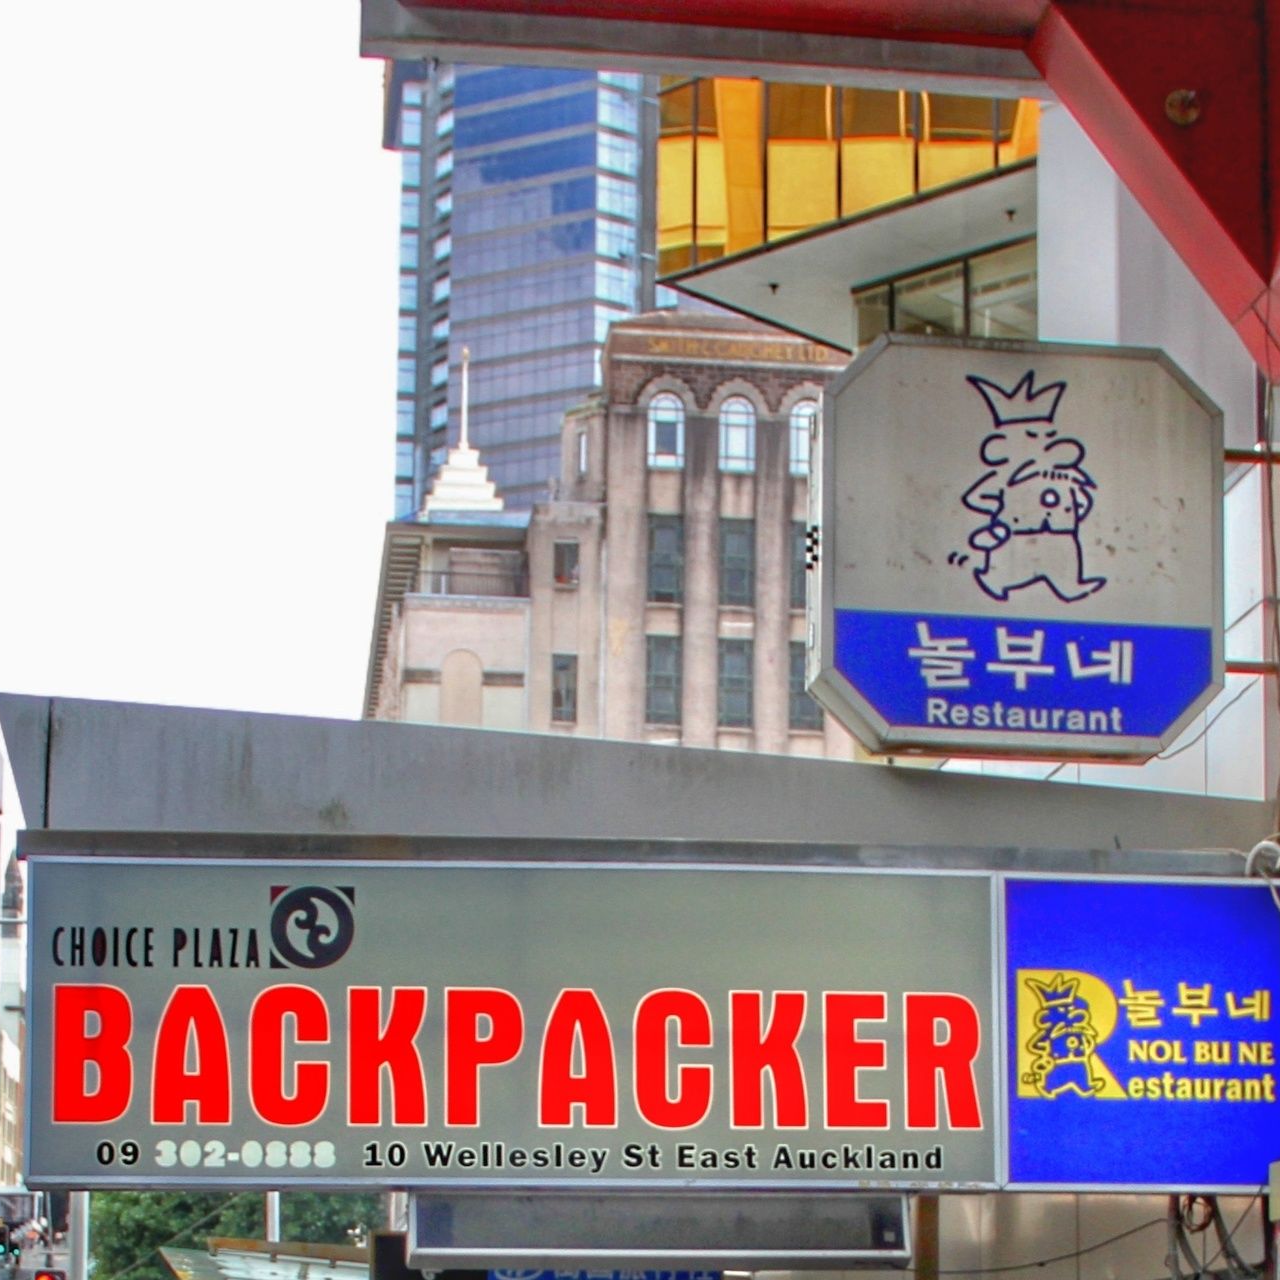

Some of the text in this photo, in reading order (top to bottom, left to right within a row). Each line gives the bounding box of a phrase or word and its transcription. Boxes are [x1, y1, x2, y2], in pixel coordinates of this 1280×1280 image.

[908, 620, 1134, 691] 놀부네
[926, 696, 1123, 733] Restaurant
[51, 926, 260, 969] CHOICE PLAZA
[1119, 980, 1270, 1028] 놀부네
[51, 983, 982, 1131] BACKPACKER
[1128, 1038, 1275, 1066] NOL BU NE
[96, 1140, 140, 1167] 09
[363, 1142, 407, 1169] 10
[423, 1143, 609, 1172] Wellesley
[622, 1143, 661, 1169] St
[677, 1144, 758, 1170] East
[773, 1144, 944, 1170] Auckland
